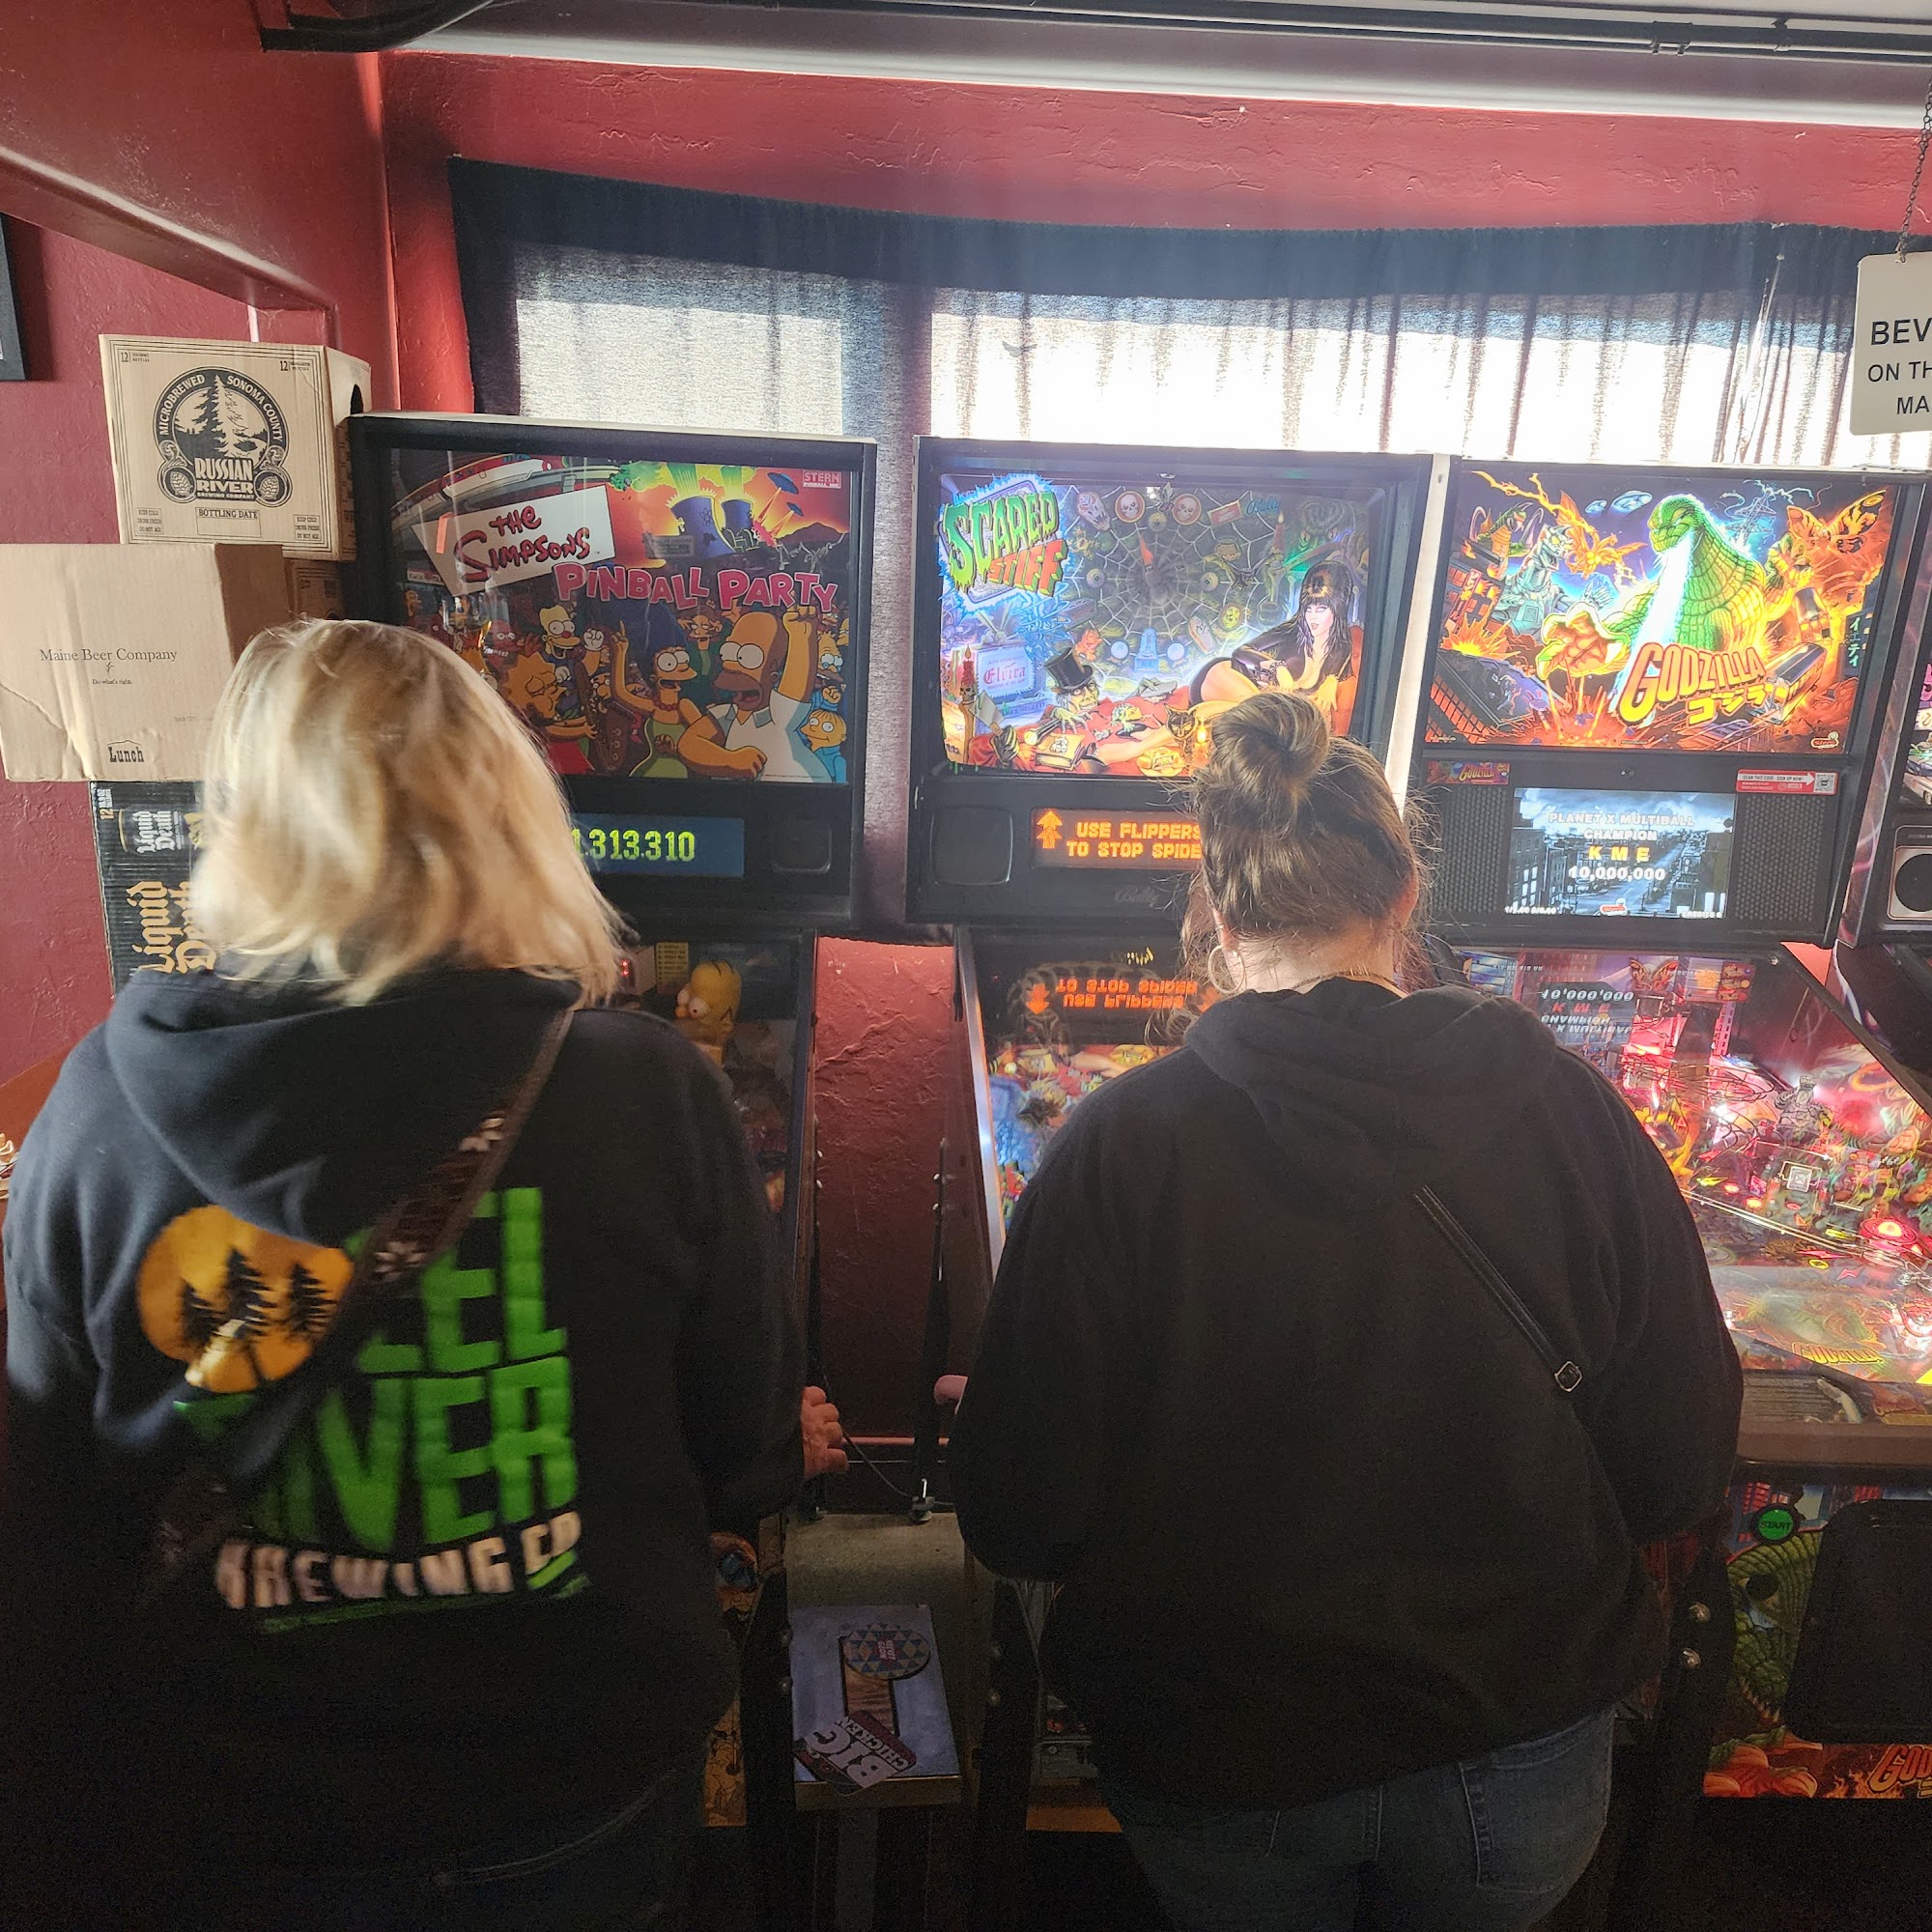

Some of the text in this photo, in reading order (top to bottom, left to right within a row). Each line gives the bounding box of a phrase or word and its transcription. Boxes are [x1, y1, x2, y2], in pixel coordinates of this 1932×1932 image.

[1870, 318, 1932, 345] BEV
[121, 352, 129, 363] 12
[280, 360, 289, 372] 12
[1867, 363, 1900, 383] ON
[158, 374, 206, 436] MICROBREWED
[226, 375, 283, 442] SONOMA COUNTY
[194, 457, 253, 481] RUSSIAN
[804, 471, 840, 483] STERN
[196, 479, 254, 495] RIVER
[198, 508, 259, 519] BOTTLING DATE
[943, 490, 1060, 595] SCARED
[453, 526, 590, 583] SIMPSONS
[987, 538, 1068, 597] STIFF
[554, 562, 838, 612] PINBALL PARTY
[39, 647, 178, 663] Maine Beer Company
[982, 666, 1026, 685] Elvira
[1618, 641, 1767, 723] GODZILLA
[108, 746, 145, 763] Lunch
[99, 808, 114, 820] 12
[1548, 811, 1695, 827] PLANET X MULTIBALL
[132, 810, 158, 853] Liquid
[152, 810, 176, 851] Death
[1076, 821, 1201, 839] USE FLIPPERS
[1583, 829, 1658, 841] CHAMPION
[1065, 840, 1203, 860] TO STOP SPIDE
[1588, 845, 1650, 863] K M E
[1569, 866, 1666, 883] 10,000,000
[127, 881, 185, 974] Liquid
[249, 1356, 578, 1550] VER
[835, 1717, 910, 1772] CHICKEN
[804, 1724, 899, 1789] BIG
